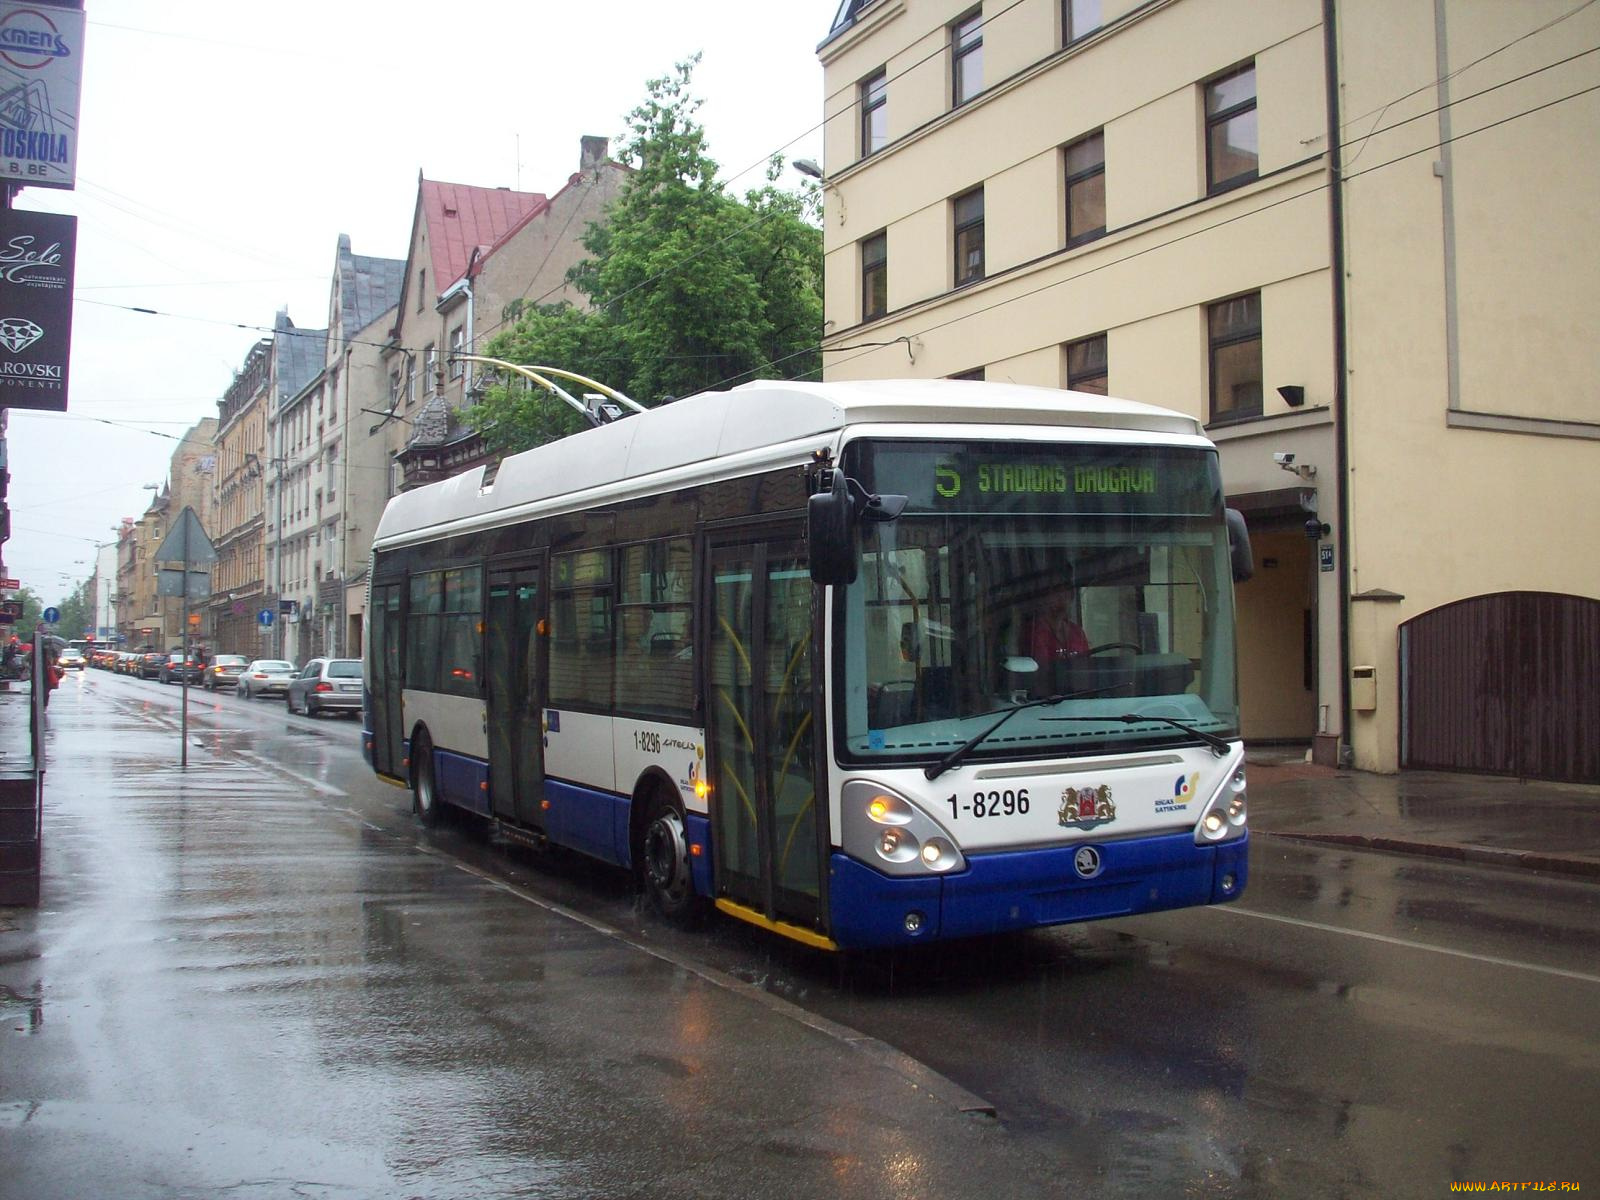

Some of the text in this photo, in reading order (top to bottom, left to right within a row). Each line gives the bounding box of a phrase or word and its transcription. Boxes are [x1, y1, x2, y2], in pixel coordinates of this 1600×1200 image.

[28, 164, 48, 176] BE
[0, 361, 61, 378] ROVSKI
[935, 464, 1155, 498] 5 STADIONS DAUGAVA
[634, 730, 661, 754] 1-8296
[947, 788, 1030, 819] 1-8296
